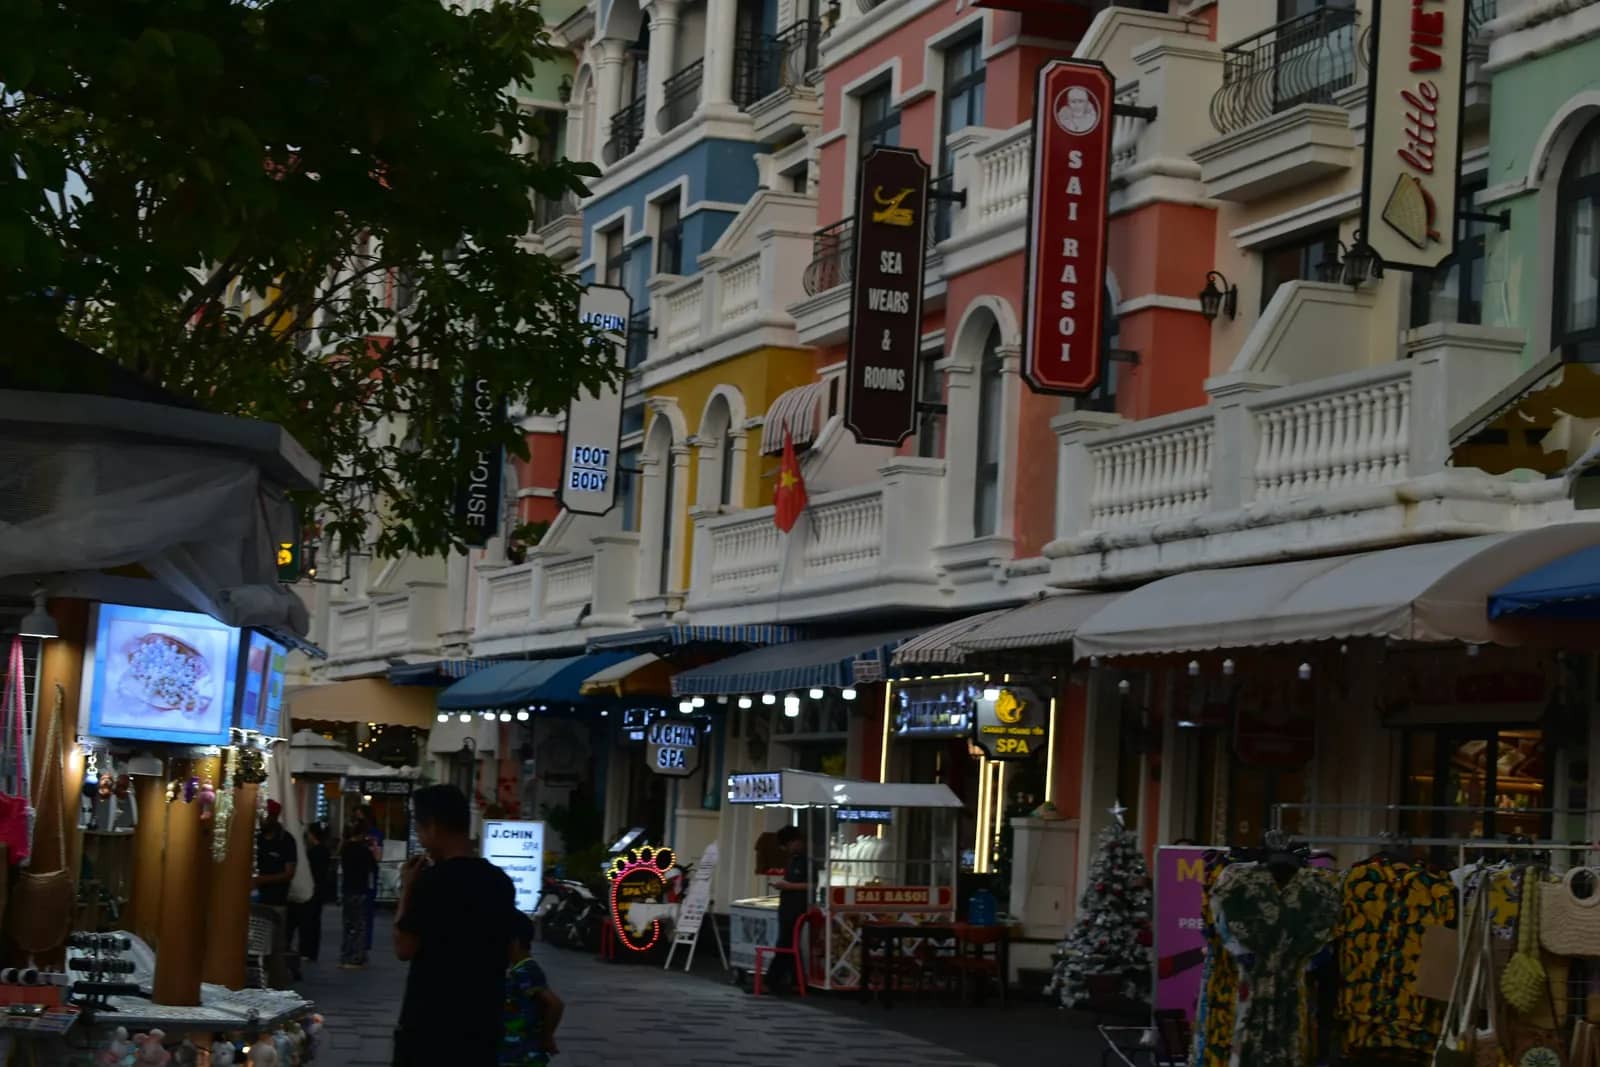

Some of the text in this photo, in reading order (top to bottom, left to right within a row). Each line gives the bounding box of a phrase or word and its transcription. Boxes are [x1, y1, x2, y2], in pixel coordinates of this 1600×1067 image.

[1398, 80, 1439, 174] little
[880, 250, 904, 275] SEA
[1058, 150, 1083, 362] SAI RASOI
[868, 287, 911, 315] WEARS
[881, 328, 892, 351] &
[864, 365, 906, 392] ROOMS
[573, 446, 610, 464] FOOT
[571, 471, 609, 491] BODY
[648, 723, 697, 746] J.CHIN
[996, 737, 1030, 754] SPA
[657, 747, 687, 768] SPA
[491, 829, 533, 839] J.CHIN
[855, 890, 929, 903] SAI RASOI
